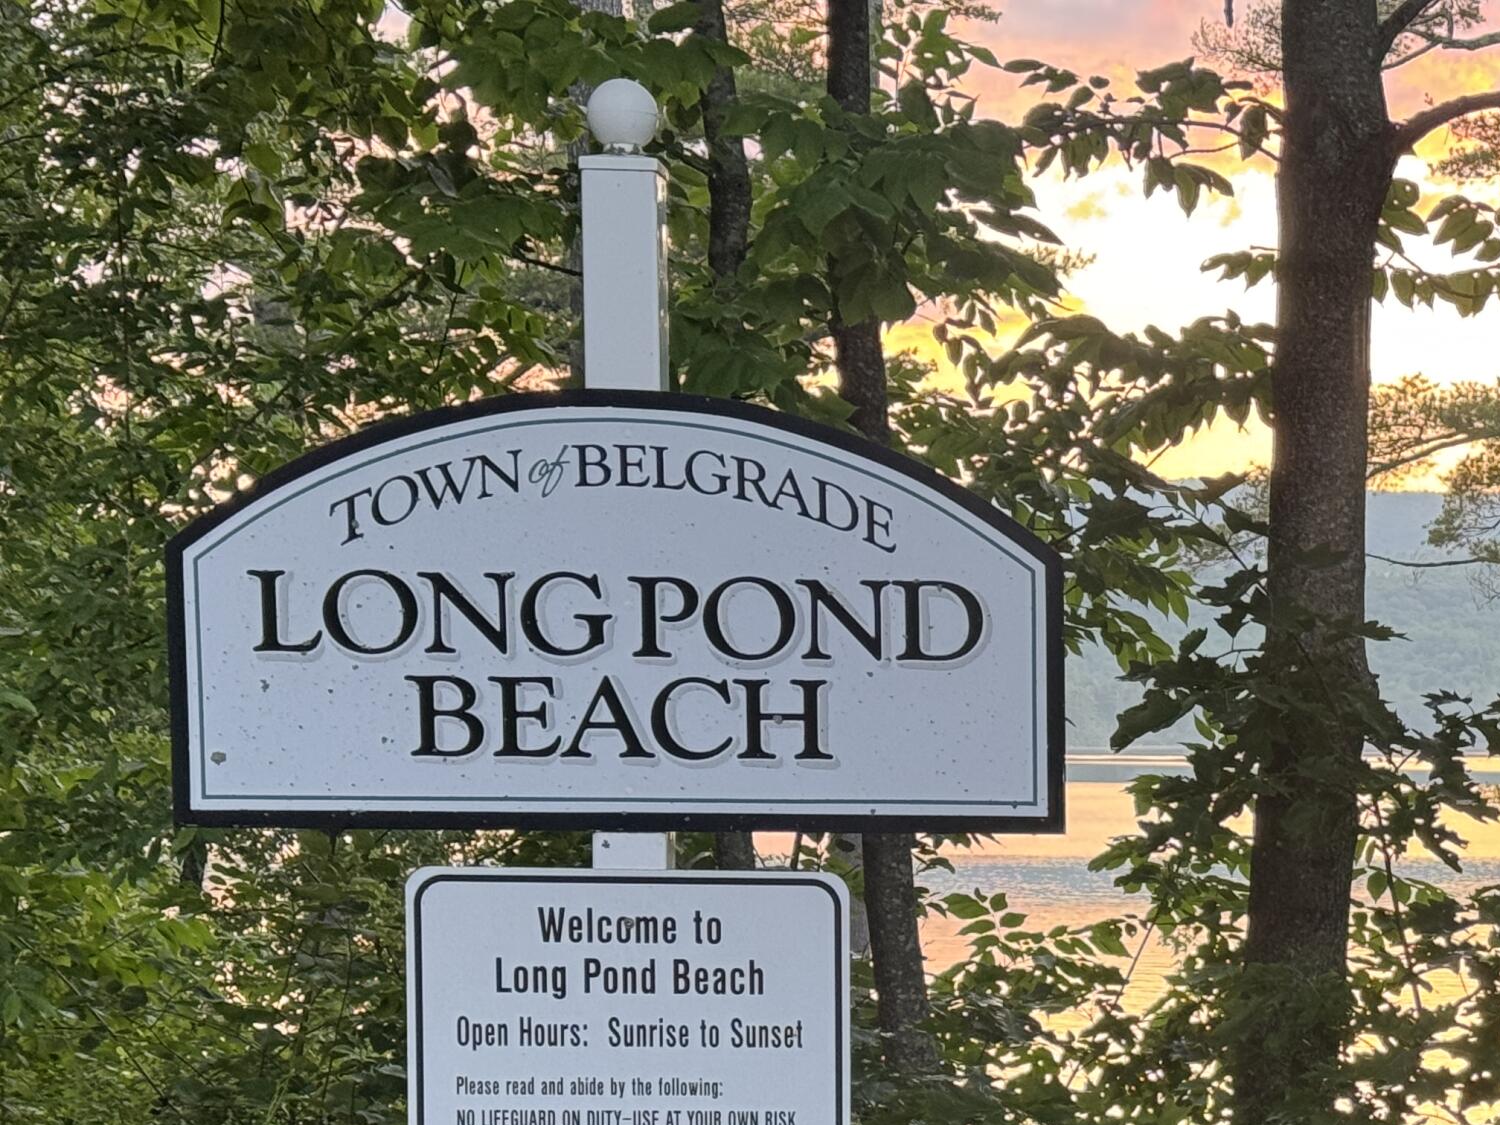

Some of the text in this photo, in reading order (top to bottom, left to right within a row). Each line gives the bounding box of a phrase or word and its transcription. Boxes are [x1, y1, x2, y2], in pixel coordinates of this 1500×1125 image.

[327, 443, 899, 554] TOWN of BELGRADE
[203, 567, 984, 662] LONG POND
[404, 675, 834, 761] BEACH
[537, 906, 722, 945] Welcome to
[495, 957, 764, 1000] Long Pond Beach
[456, 1015, 803, 1051] Open Hours: Sunrise to Sunset
[456, 1075, 723, 1100] Please read and abide by the following:
